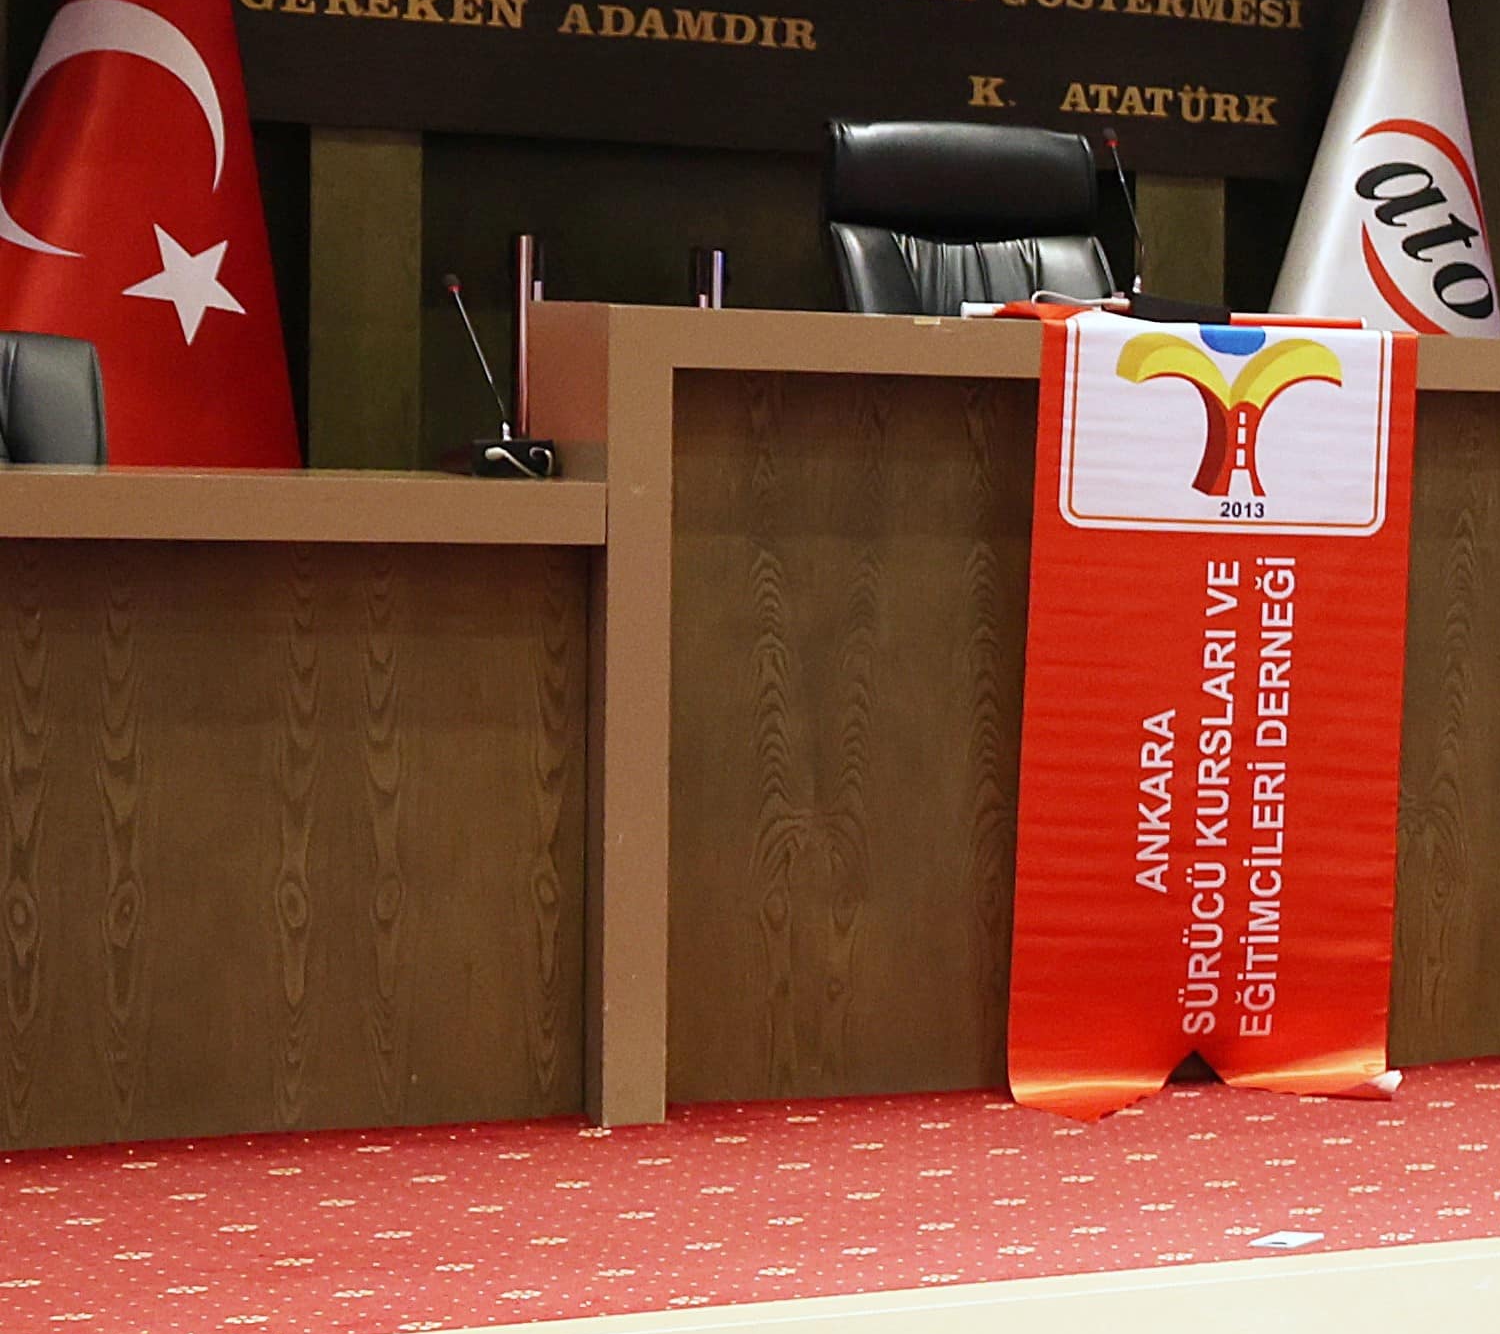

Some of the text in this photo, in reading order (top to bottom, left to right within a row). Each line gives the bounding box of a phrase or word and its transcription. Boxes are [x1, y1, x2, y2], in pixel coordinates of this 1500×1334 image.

[558, 3, 816, 51] ADAMDIR
[1059, 81, 1279, 126] ATATÜRK
[1355, 162, 1494, 319] ato
[1220, 501, 1266, 519] 2013
[1135, 707, 1176, 894] ANKARA
[1177, 560, 1240, 1035] SÜRÜCÜ KURSLARI VE
[1234, 556, 1297, 1037] EĞİTİMCİLERİ DERNEĞİ
